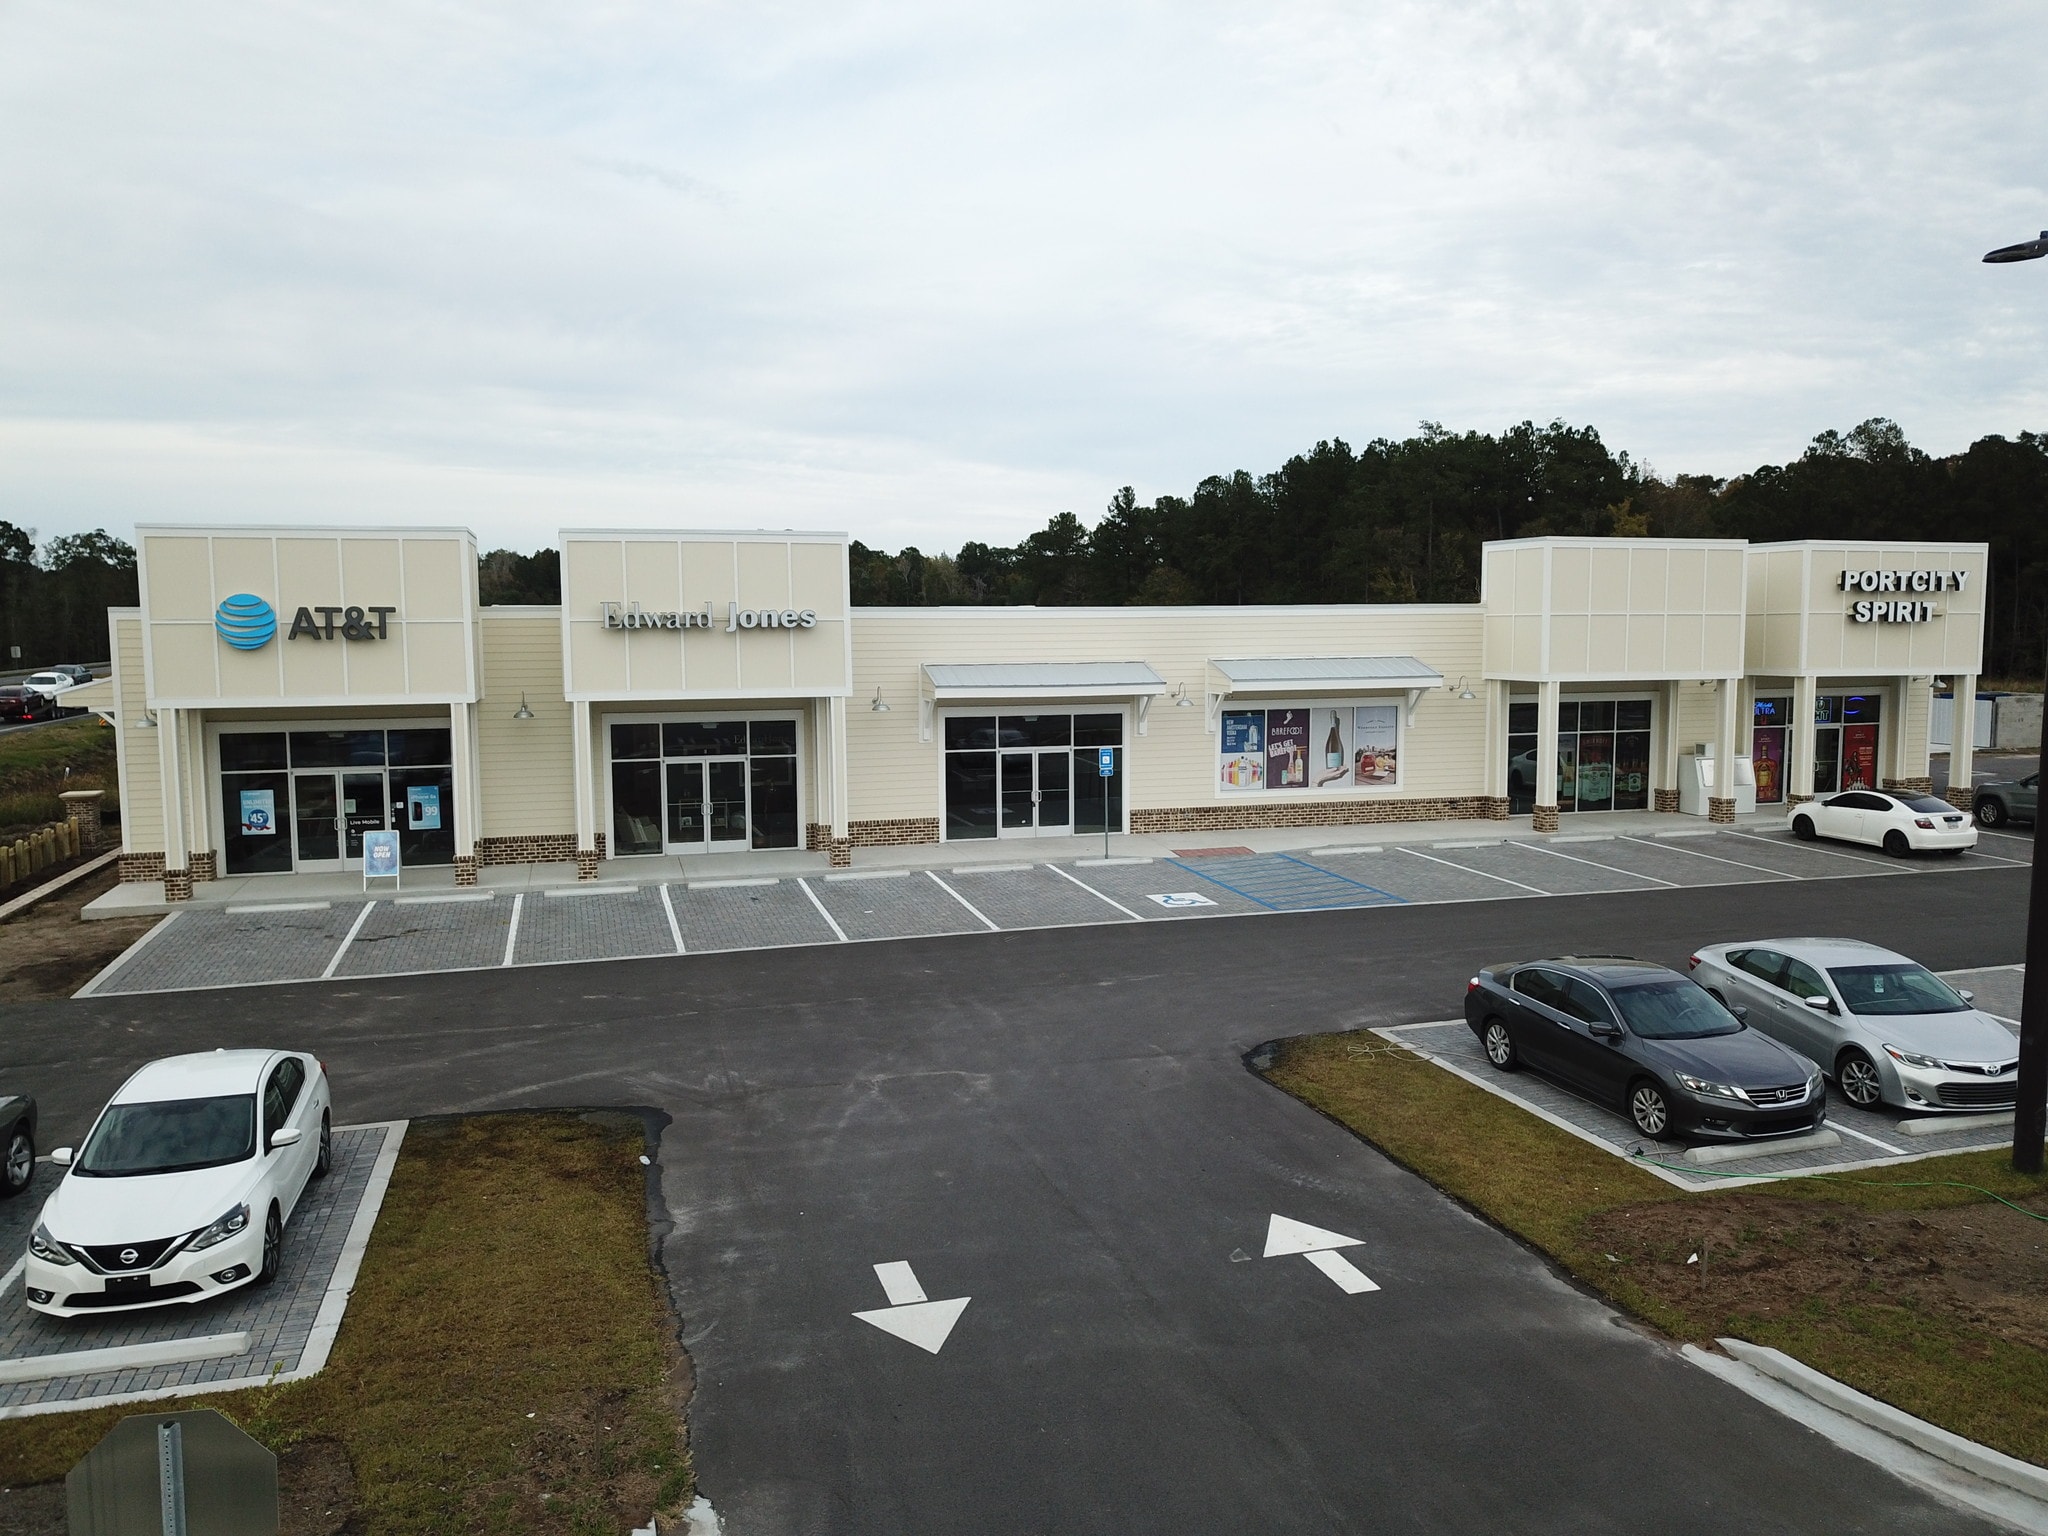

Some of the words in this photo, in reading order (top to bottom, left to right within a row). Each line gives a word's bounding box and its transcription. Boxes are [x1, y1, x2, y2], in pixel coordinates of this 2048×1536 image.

[1841, 570, 1971, 592] PORTCITY
[600, 601, 716, 630] Edward
[725, 601, 818, 633] Jones
[1853, 600, 1938, 623] SPIRIT
[288, 605, 397, 641] AT&T
[1271, 726, 1303, 736] BAREFOOT
[1283, 738, 1294, 747] GET
